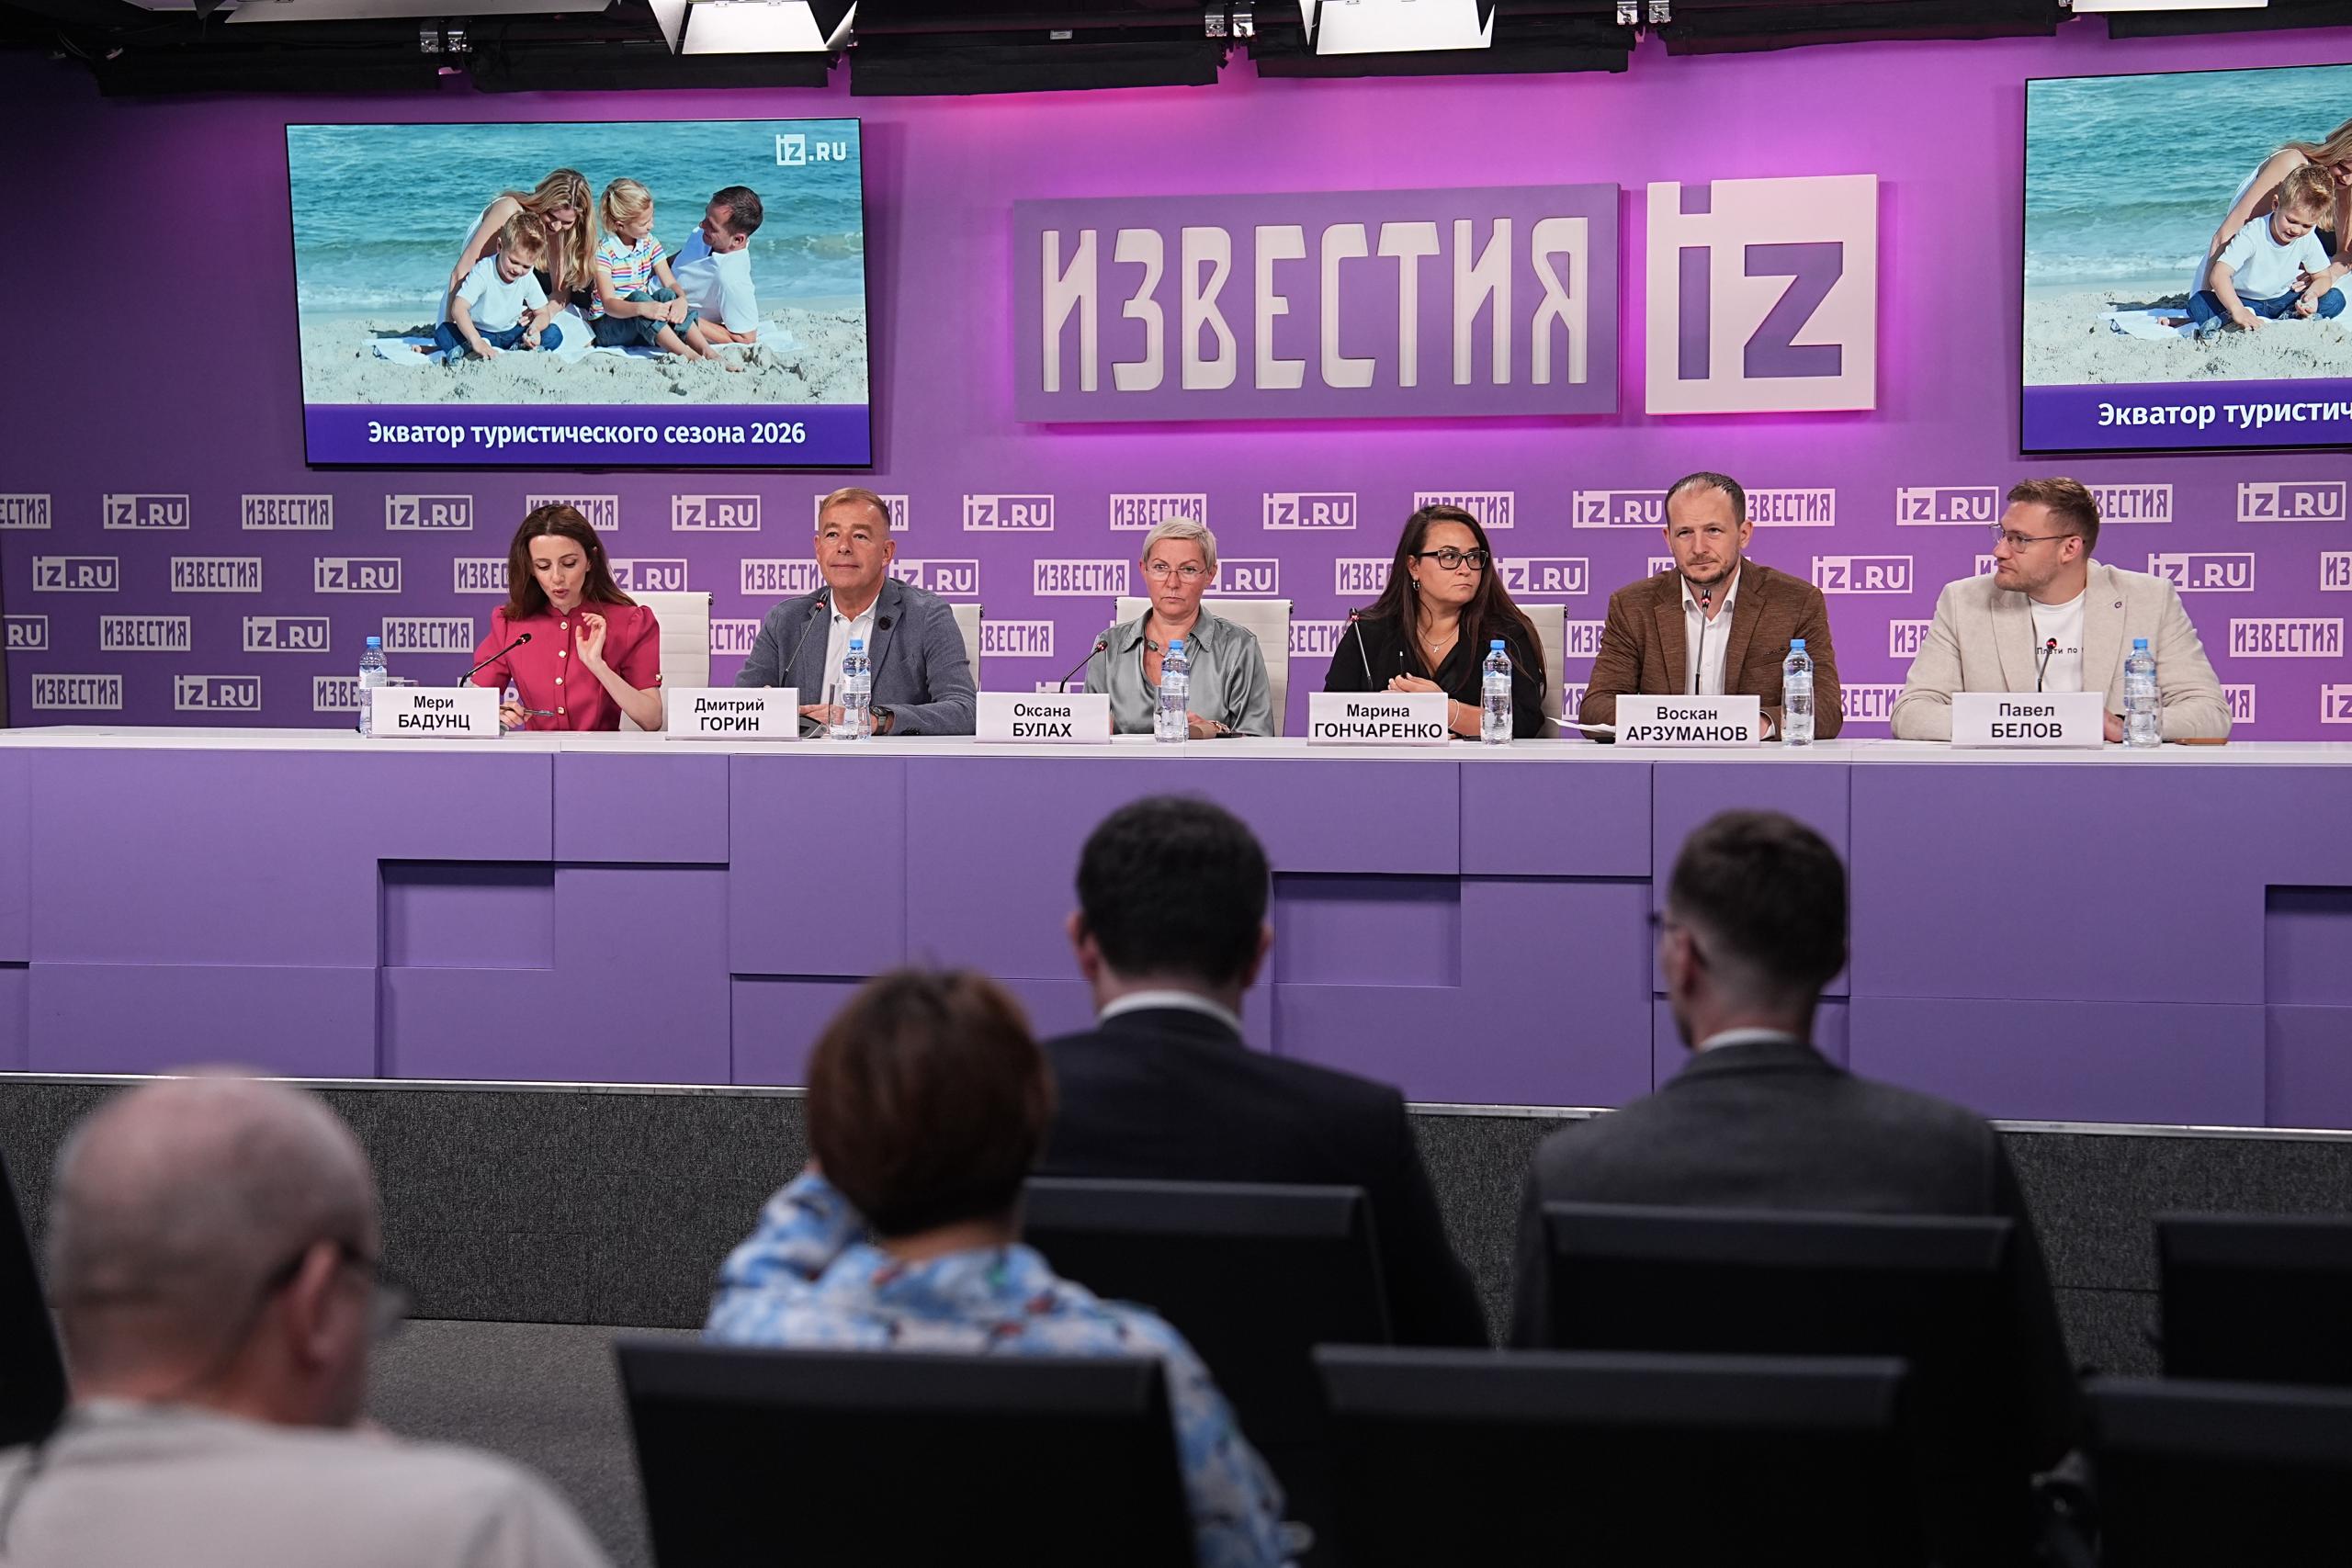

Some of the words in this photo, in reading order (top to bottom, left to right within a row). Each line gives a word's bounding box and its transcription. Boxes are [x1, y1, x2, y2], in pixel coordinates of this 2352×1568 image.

[1042, 217, 1589, 392] ИЗВЕСТИЯ
[2098, 402, 2215, 429] Экватор
[2223, 400, 2352, 430] туристич
[368, 422, 465, 448] Экватор
[470, 425, 658, 448] туристического
[664, 425, 746, 444] сезона
[752, 422, 806, 444] 2026
[0, 498, 48, 525] ЕСТИЯ
[245, 498, 330, 525] ИЗВЕСТИЯ
[1747, 493, 1831, 522] ЗВЕСТИЯ
[2094, 489, 2168, 518] ВЕСТИЯ
[175, 561, 258, 589] ИЗВЕСТИЯ
[613, 567, 681, 591] z.RU
[744, 563, 823, 591] ИЗВЕСТИ
[1038, 563, 1126, 592] ИЗВЕСТИЯ
[104, 620, 187, 647] ИЗВЕСТИЯ
[386, 621, 471, 649] ИЗВЕСТИЯ
[981, 626, 1049, 652] ВЕСТИЯ
[2234, 623, 2338, 652] ИЗВЕСТИЯ
[35, 679, 119, 706] ИЗВЕСТИЯ
[317, 680, 360, 707] ИЗВЕ
[413, 695, 454, 712] Мери
[694, 697, 764, 715] Дмитрий
[1013, 703, 1071, 717] Оксана
[1346, 704, 1410, 717] Марина
[1657, 706, 1718, 720] Воскан
[1999, 703, 2054, 716] Павел
[398, 714, 470, 731] БАДУНЦ
[700, 716, 760, 732] ГОРИН
[1012, 722, 1072, 738] БУЛАХ
[1315, 722, 1442, 739] ГОНЧАРЕНКО
[1626, 726, 1748, 741] АРЗУМАНОВ
[1991, 722, 2063, 739] БЕЛОВ
